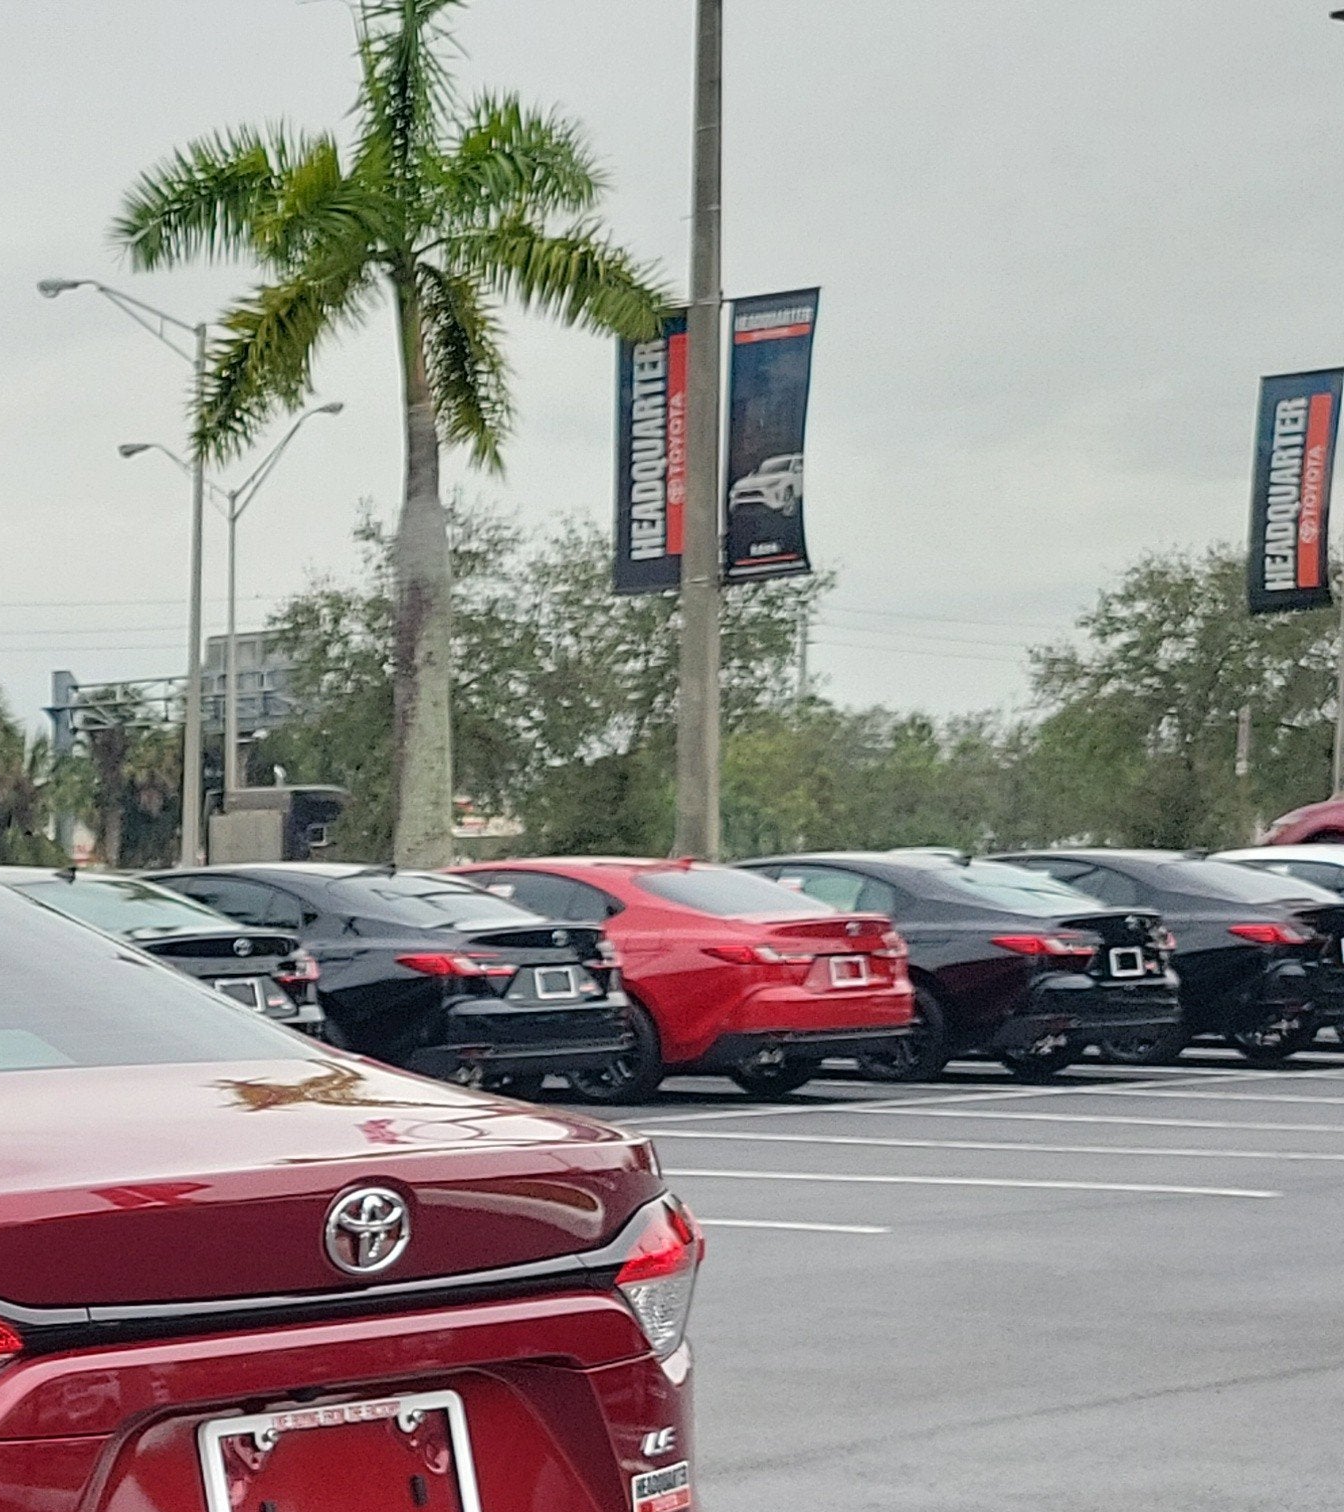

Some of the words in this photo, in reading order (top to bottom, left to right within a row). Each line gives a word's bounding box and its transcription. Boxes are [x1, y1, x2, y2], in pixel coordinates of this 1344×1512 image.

[630, 340, 667, 560] HEADQUARTER
[1265, 396, 1309, 591] HEADQUARTER
[640, 1426, 676, 1457] LE
